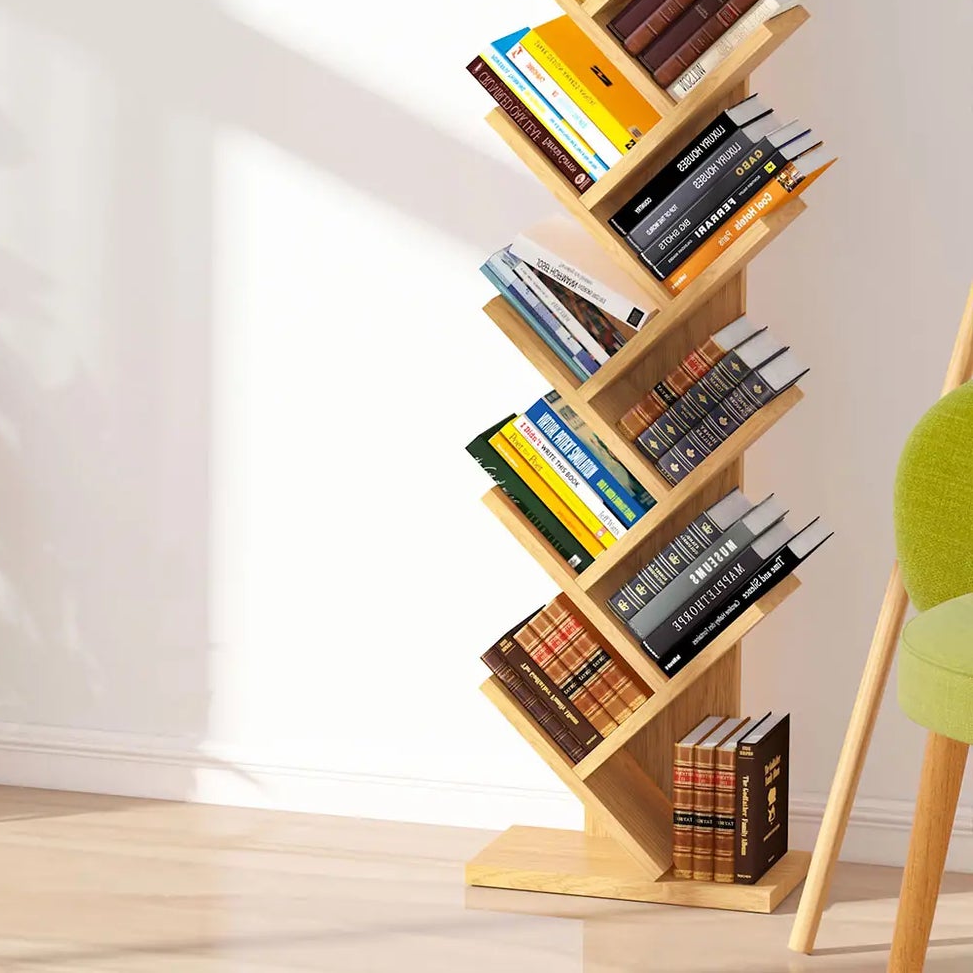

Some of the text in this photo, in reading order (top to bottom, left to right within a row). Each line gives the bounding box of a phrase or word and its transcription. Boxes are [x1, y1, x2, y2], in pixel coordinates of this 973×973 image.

[523, 425, 543, 446] Didn't
[540, 444, 557, 462] WRITE
[553, 459, 568, 474] THIS
[564, 471, 580, 487] BOOK
[535, 411, 599, 479] VIRTUAL PATIENT SIMULATION
[740, 818, 748, 836] Family
